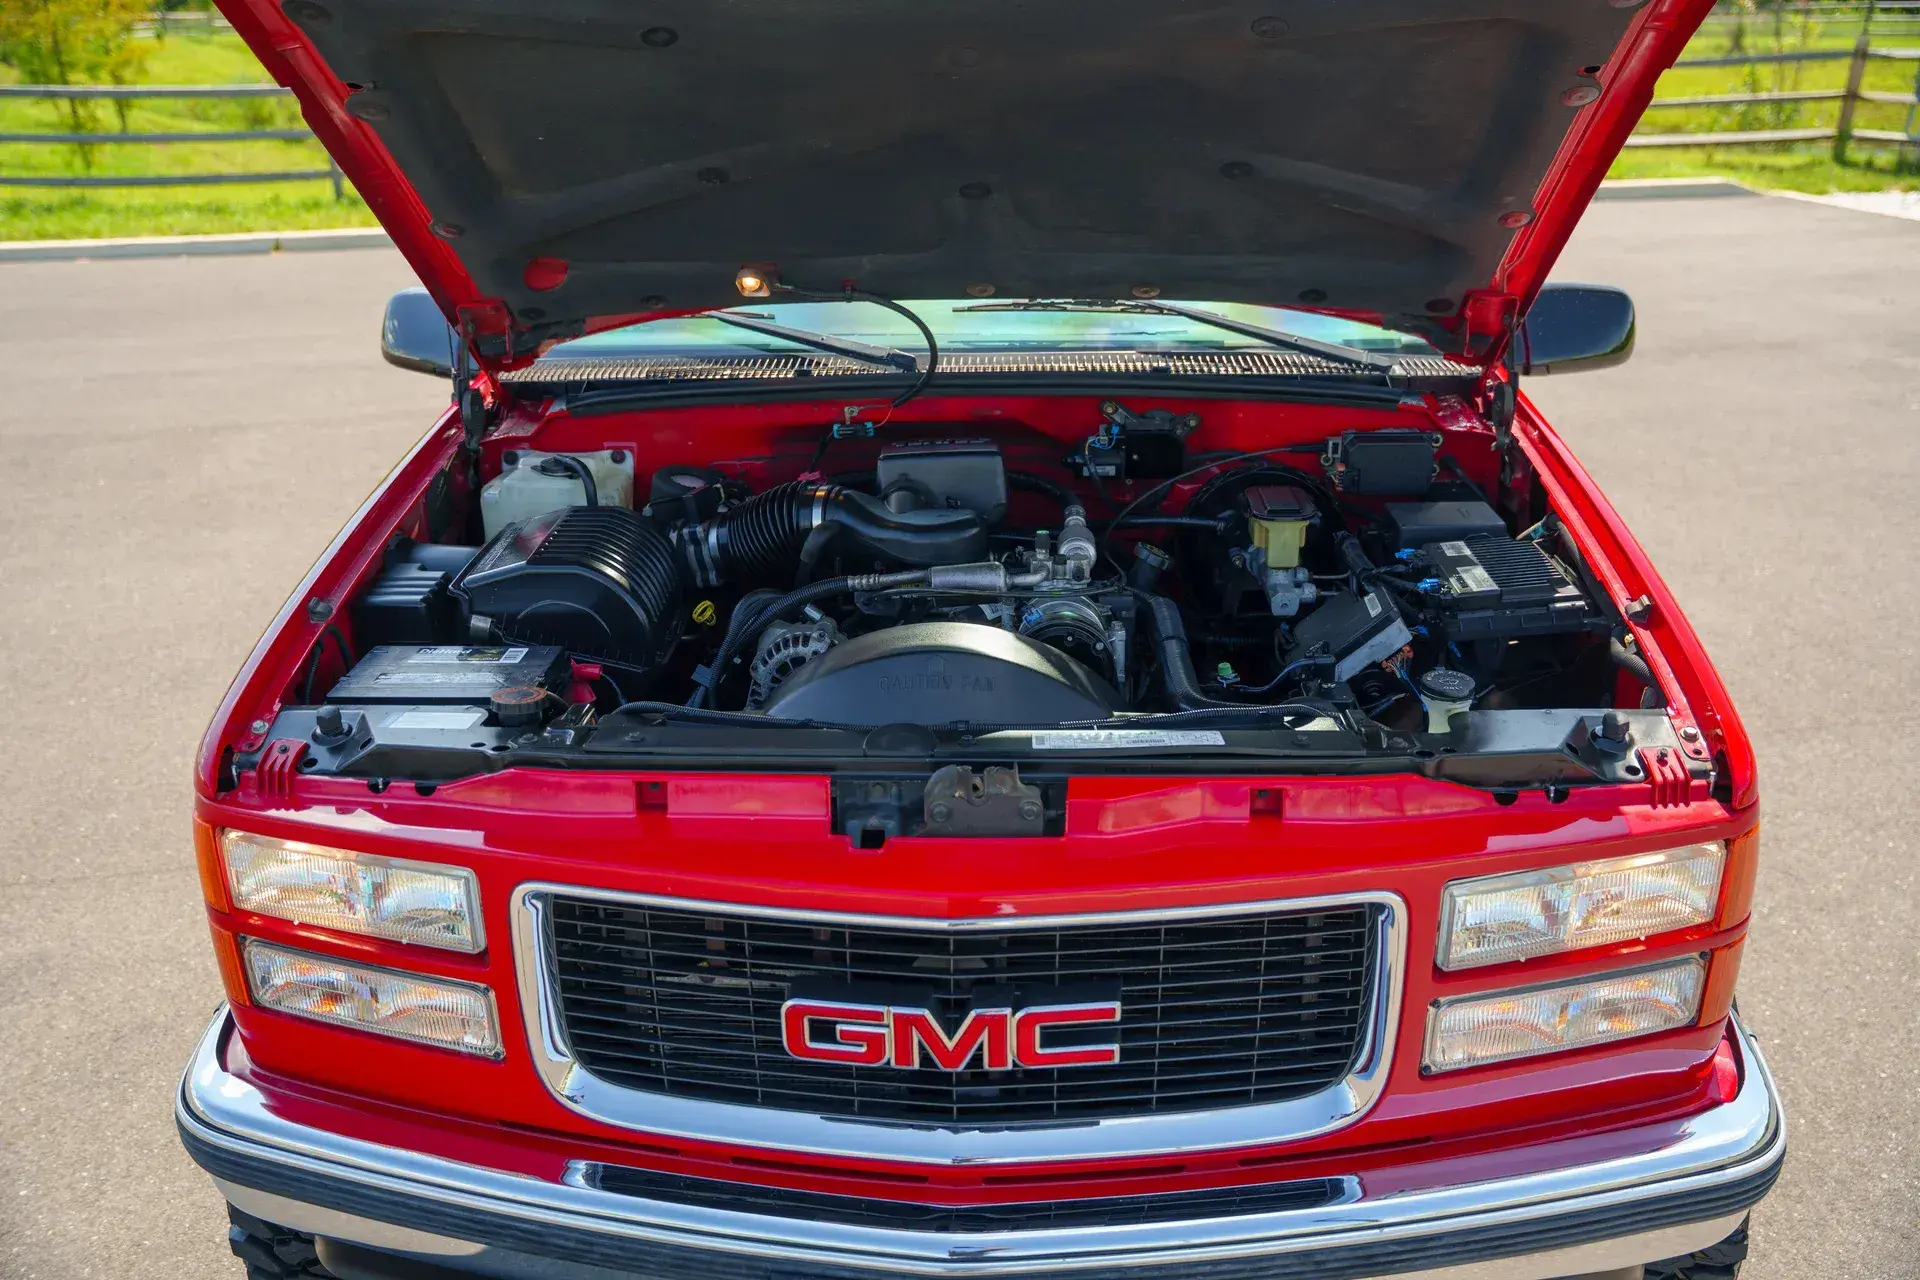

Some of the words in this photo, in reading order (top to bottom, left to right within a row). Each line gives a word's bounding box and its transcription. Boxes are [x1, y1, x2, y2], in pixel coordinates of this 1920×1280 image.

[879, 674, 952, 692] CAUTION
[961, 675, 996, 692] FAN
[781, 998, 1122, 1070] GMC
